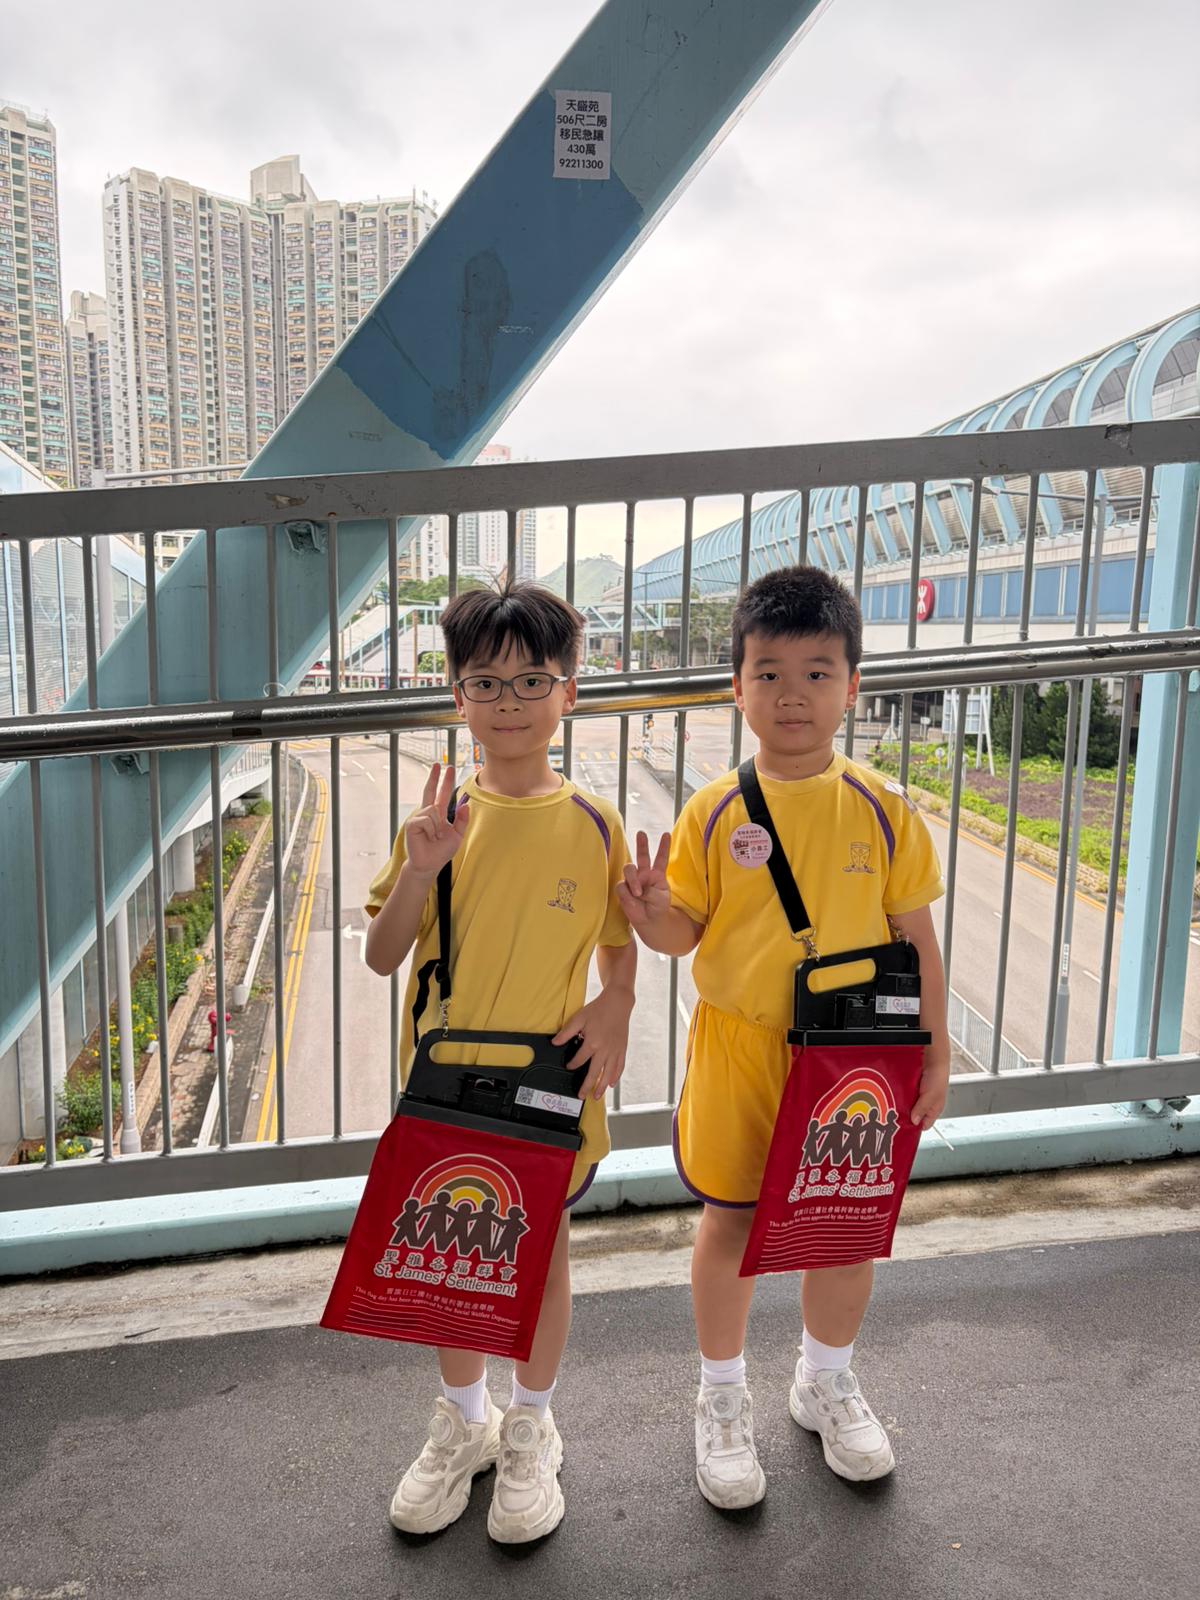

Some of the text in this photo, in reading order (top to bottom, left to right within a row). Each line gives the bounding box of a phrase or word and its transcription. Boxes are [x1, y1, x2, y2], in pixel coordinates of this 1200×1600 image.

[566, 99, 599, 112] 天盛苑
[556, 114, 607, 127] 506尺二房
[560, 128, 604, 141] 移民急讓
[567, 143, 596, 156] 430萬
[559, 158, 604, 169] 92211300
[839, 1181, 894, 1198] Settlement
[382, 1249, 518, 1281] 聖雅各福群會
[374, 1262, 517, 1297] St. James' Settlement
